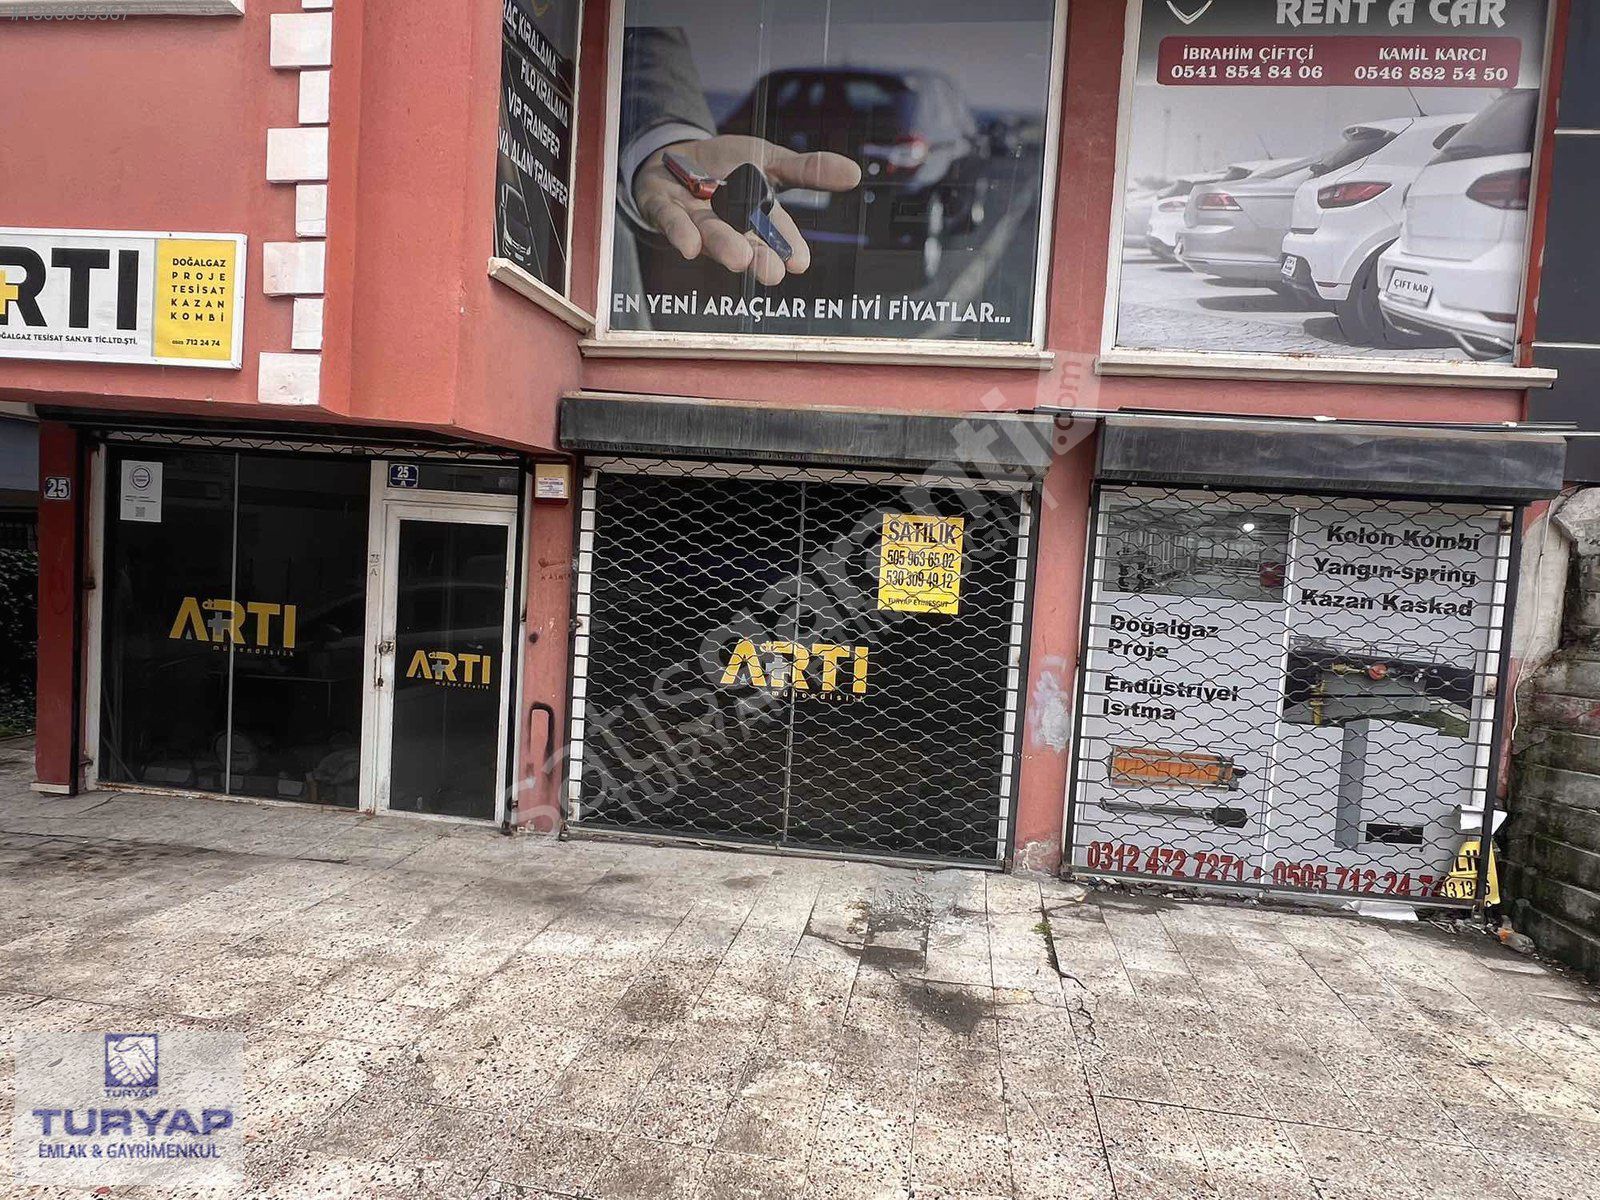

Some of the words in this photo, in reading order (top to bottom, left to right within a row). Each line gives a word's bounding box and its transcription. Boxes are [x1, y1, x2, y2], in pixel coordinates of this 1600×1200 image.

[1276, 0, 1376, 27] RENT
[1388, 0, 1414, 27] A
[1428, 0, 1506, 28] CAR
[1183, 45, 1253, 60] İBRAHİM
[1258, 45, 1314, 63] ÇİFTÇİ
[1379, 45, 1429, 61] KAMİL
[1435, 48, 1487, 61] KARCI
[1171, 65, 1217, 79] 0541
[1225, 65, 1261, 79] 854
[1268, 65, 1292, 79] 84
[1299, 65, 1323, 79] 06
[1354, 66, 1403, 80] 0546
[1409, 66, 1446, 80] 882
[1452, 67, 1477, 81] 54
[1483, 67, 1509, 81] 50
[523, 102, 560, 159] TRANSFER
[534, 157, 568, 208] TRANSFER
[172, 257, 226, 267] DOĞALGAZ
[172, 271, 225, 281] PROJE
[171, 284, 225, 295] TESİSAT
[1413, 280, 1429, 294] KAR
[171, 298, 224, 308] KAZAN
[613, 293, 640, 313] EN
[646, 290, 698, 315] YENİ
[703, 295, 806, 322] ARAÇLAR
[814, 298, 843, 319] EN
[851, 294, 881, 320] İYİ
[170, 312, 224, 322] KOMBİ
[33, 332, 63, 342] TESİSAT
[186, 338, 198, 346] 712
[397, 465, 409, 479] 25
[47, 478, 68, 498] 25
[889, 520, 956, 544] SATILIK
[1327, 525, 1395, 546] Kolon
[1403, 529, 1480, 550] Kombi
[888, 549, 905, 565] 505
[908, 550, 926, 567] 963
[928, 551, 940, 567] 65
[943, 552, 955, 568] 02
[886, 570, 904, 586] 530
[906, 570, 925, 587] 309
[926, 571, 939, 588] 49
[942, 572, 953, 589] 12
[1302, 588, 1374, 610] Kazan
[1382, 593, 1473, 617] Kaskad
[169, 596, 297, 649] ARTI
[1110, 614, 1220, 641] Doğalgaz
[1107, 638, 1169, 662] Proje
[406, 650, 492, 684] ARTI
[719, 638, 870, 694] ARTI
[1087, 841, 1140, 873] 0312
[1145, 846, 1187, 877] 472
[1192, 851, 1244, 882] 7271
[1272, 860, 1328, 890] 0505
[1335, 866, 1377, 895] 712
[1384, 871, 1411, 897] 24
